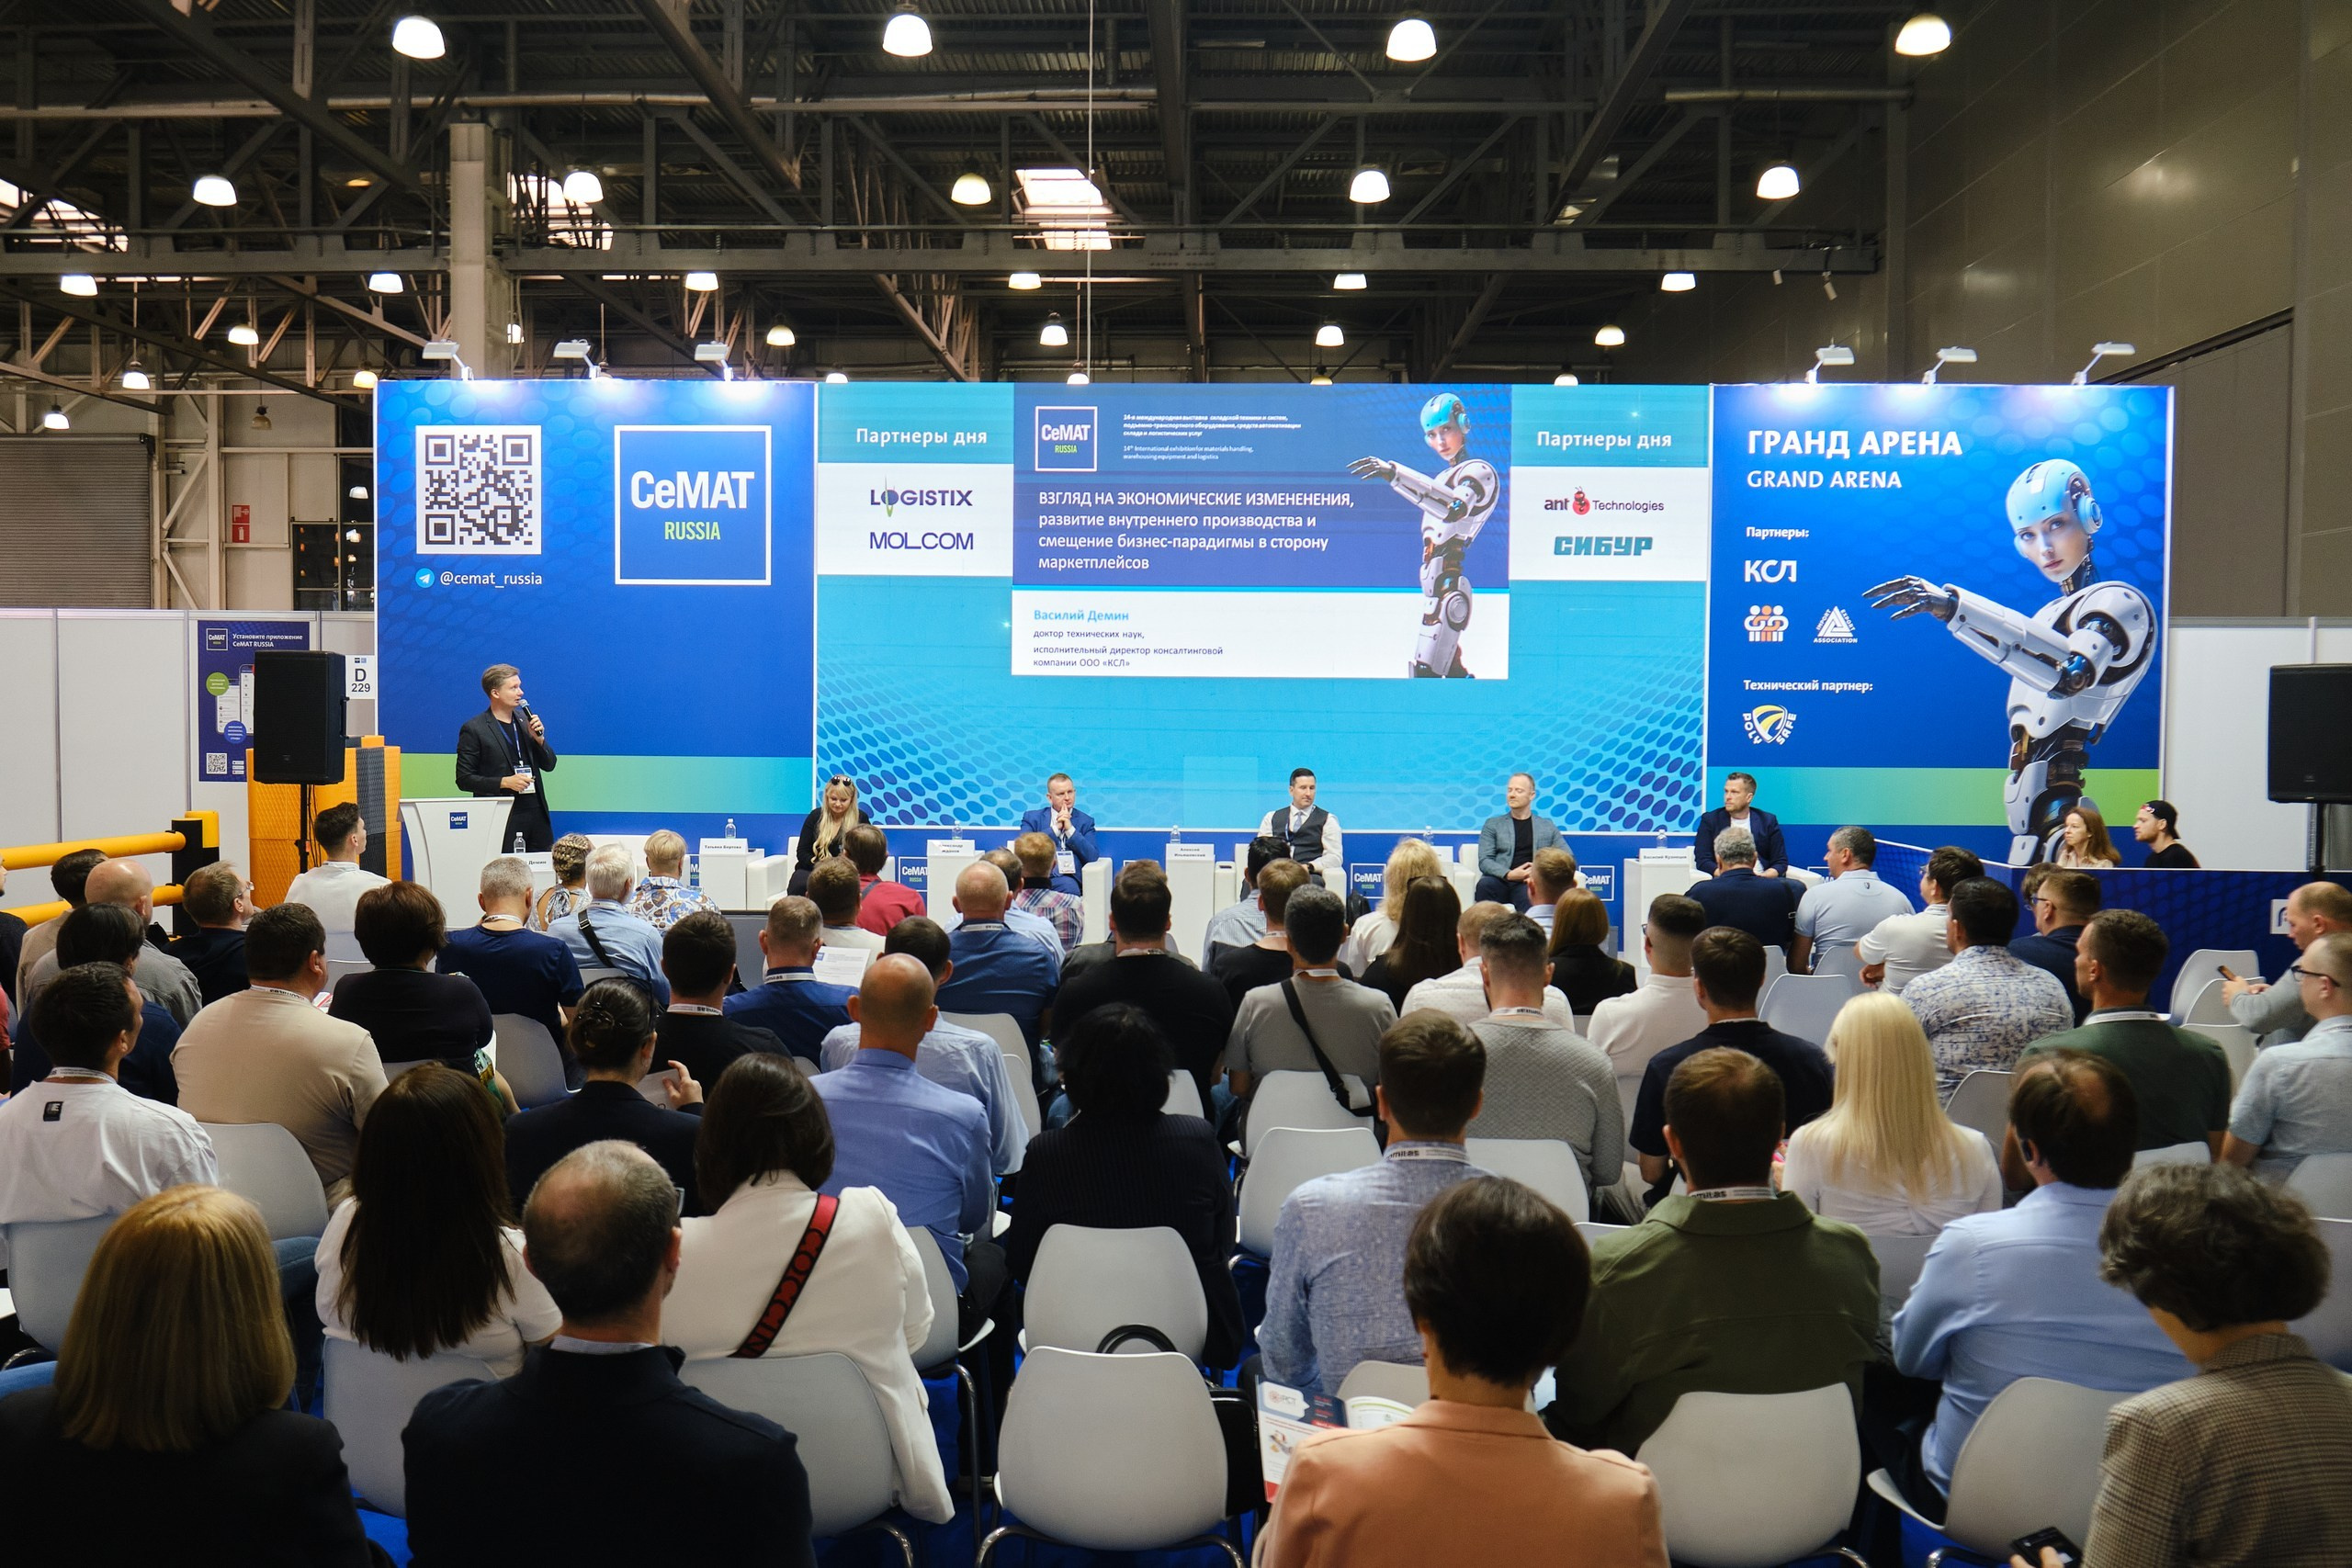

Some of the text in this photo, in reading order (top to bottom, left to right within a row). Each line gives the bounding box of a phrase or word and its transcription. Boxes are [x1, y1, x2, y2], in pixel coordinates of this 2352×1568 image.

[856, 428, 988, 448] Партнеры дня
[1041, 424, 1091, 441] CeMAT
[1537, 431, 1672, 451] Партнеры дня
[1055, 445, 1078, 454] RUSSIA
[1748, 430, 1963, 459] ГРАНД АРЕНА
[1747, 469, 1903, 489] GRAND ARENA
[630, 470, 755, 509] CeMAT
[1039, 491, 1354, 508] ВЗГЛЯД НА ЭКОНОМИЧЕСКИЕ ИЗМЕНЕНЕНИЯ,
[1544, 499, 1665, 513] ant Technologies
[664, 521, 721, 540] RUSSIA
[1039, 514, 1317, 530] развитие внутреннего производства и
[1746, 526, 1809, 540] Партнеры:
[1038, 534, 1329, 551] смещение бизнес-парадигмы в сторону
[1554, 536, 1654, 557] СИБУР
[1038, 555, 1150, 571] маркетплейсов
[1744, 559, 1798, 583] КСЛ
[440, 570, 543, 590] @cemat_russia
[1034, 609, 1129, 623] Василий Демин
[1815, 608, 1832, 631] IMPORT
[1840, 609, 1856, 631] EXPORT
[266, 634, 303, 642] приложение
[1034, 630, 1145, 639] доктор технических наук,
[1034, 645, 1224, 656] исполнительный директор консалтинговой
[1034, 659, 1130, 668] компании ООО «КСЛ»
[355, 668, 367, 682] D
[351, 683, 371, 694] 229
[1743, 679, 1873, 694] Технический партнер:
[1743, 713, 1763, 745] POLY
[1775, 713, 1797, 745] SAFE
[1354, 873, 1383, 883] CeMAT
